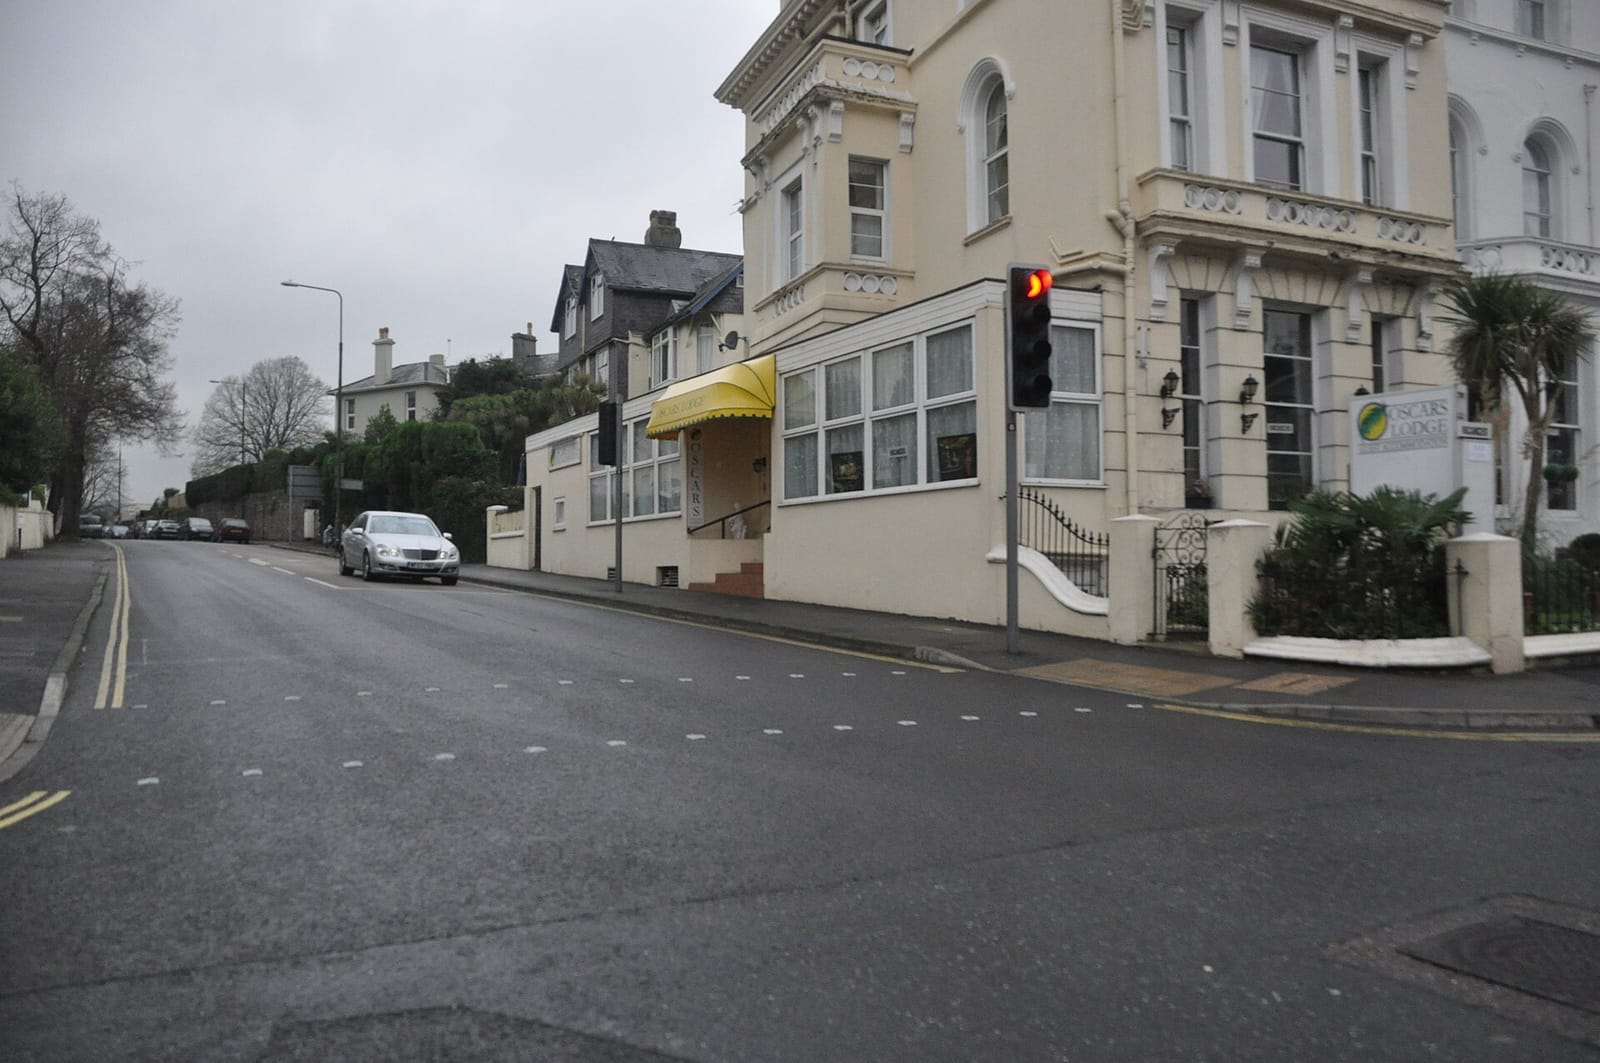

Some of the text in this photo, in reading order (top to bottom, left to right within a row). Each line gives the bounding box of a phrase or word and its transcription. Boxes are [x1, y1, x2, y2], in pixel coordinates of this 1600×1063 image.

[1389, 401, 1448, 420] OSCARS
[1391, 418, 1448, 436] LODGE
[690, 444, 702, 516] OSCARS
